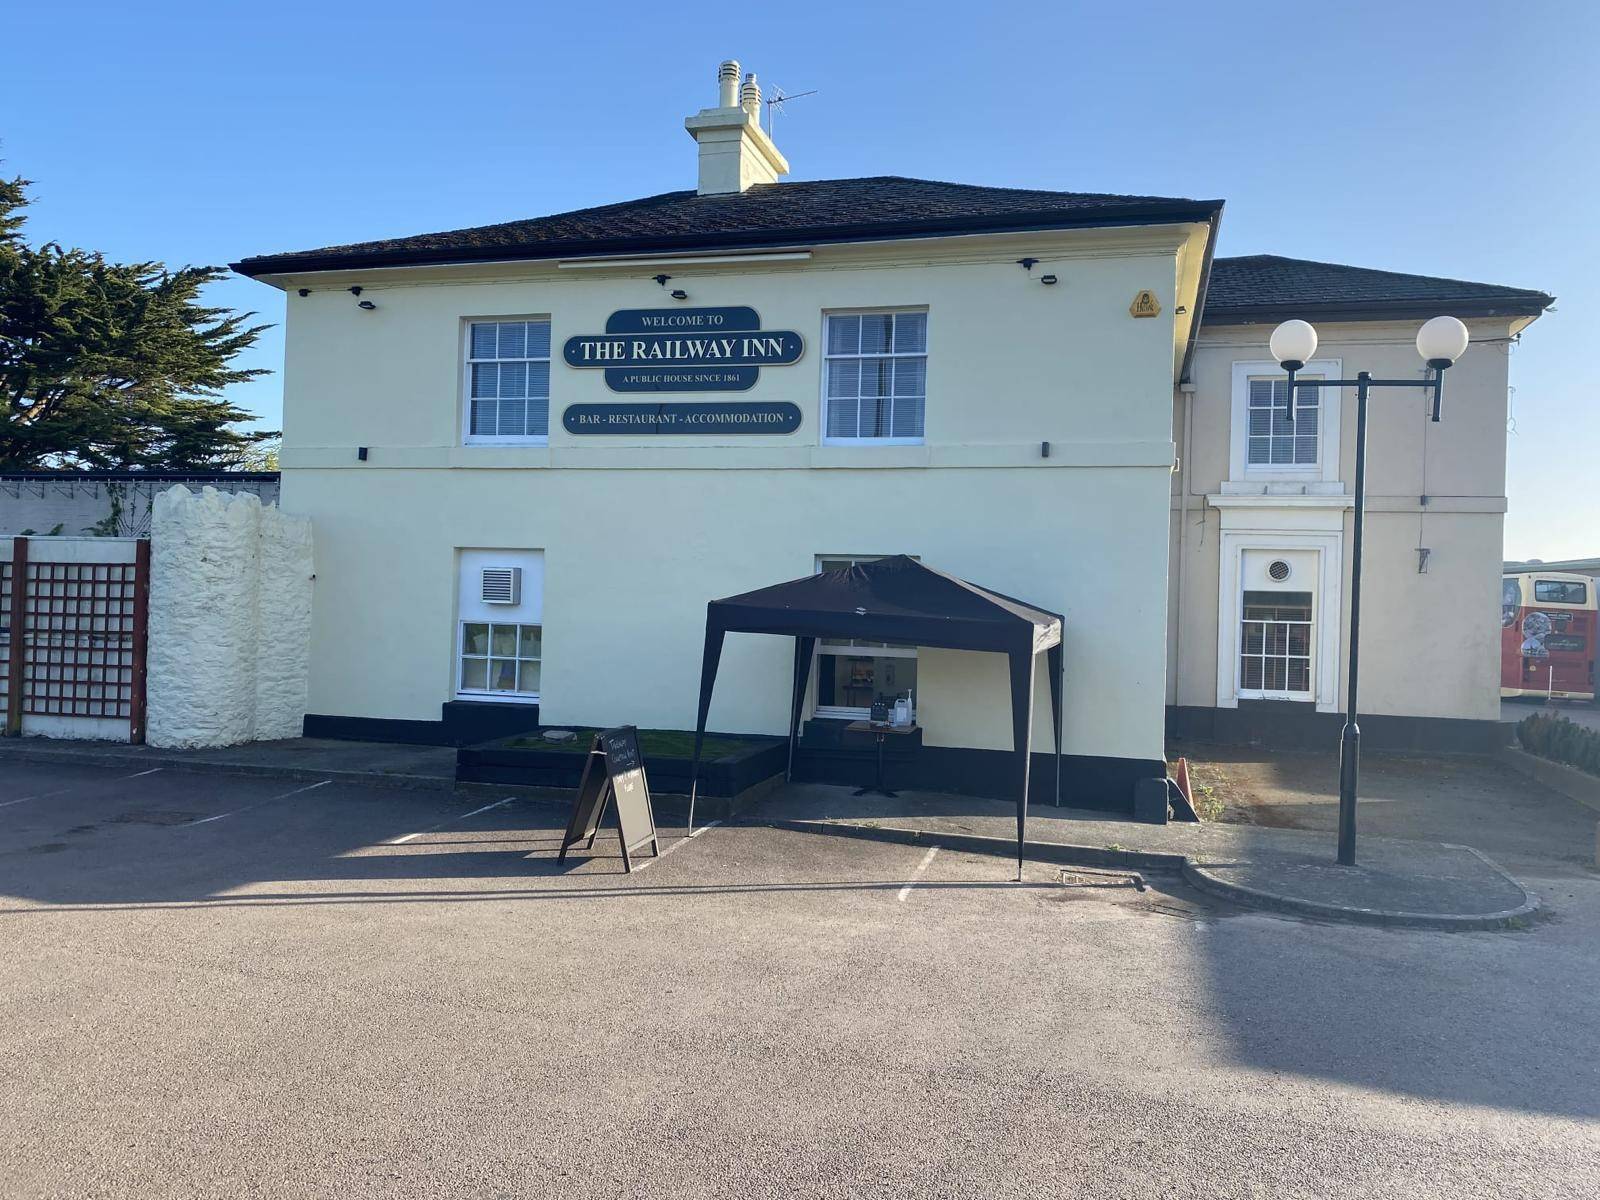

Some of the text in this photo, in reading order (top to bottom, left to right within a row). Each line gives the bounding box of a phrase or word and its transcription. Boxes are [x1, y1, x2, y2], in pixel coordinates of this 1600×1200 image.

[642, 315, 724, 327] WELCOME TO
[580, 337, 784, 360] THE RAILWAY INN
[622, 374, 740, 383] A PUBLIC HOUSE SINCE 1861
[579, 414, 601, 424] BAR
[608, 413, 677, 424] RESTAURANT
[684, 412, 784, 424] ACCOMMODATION
